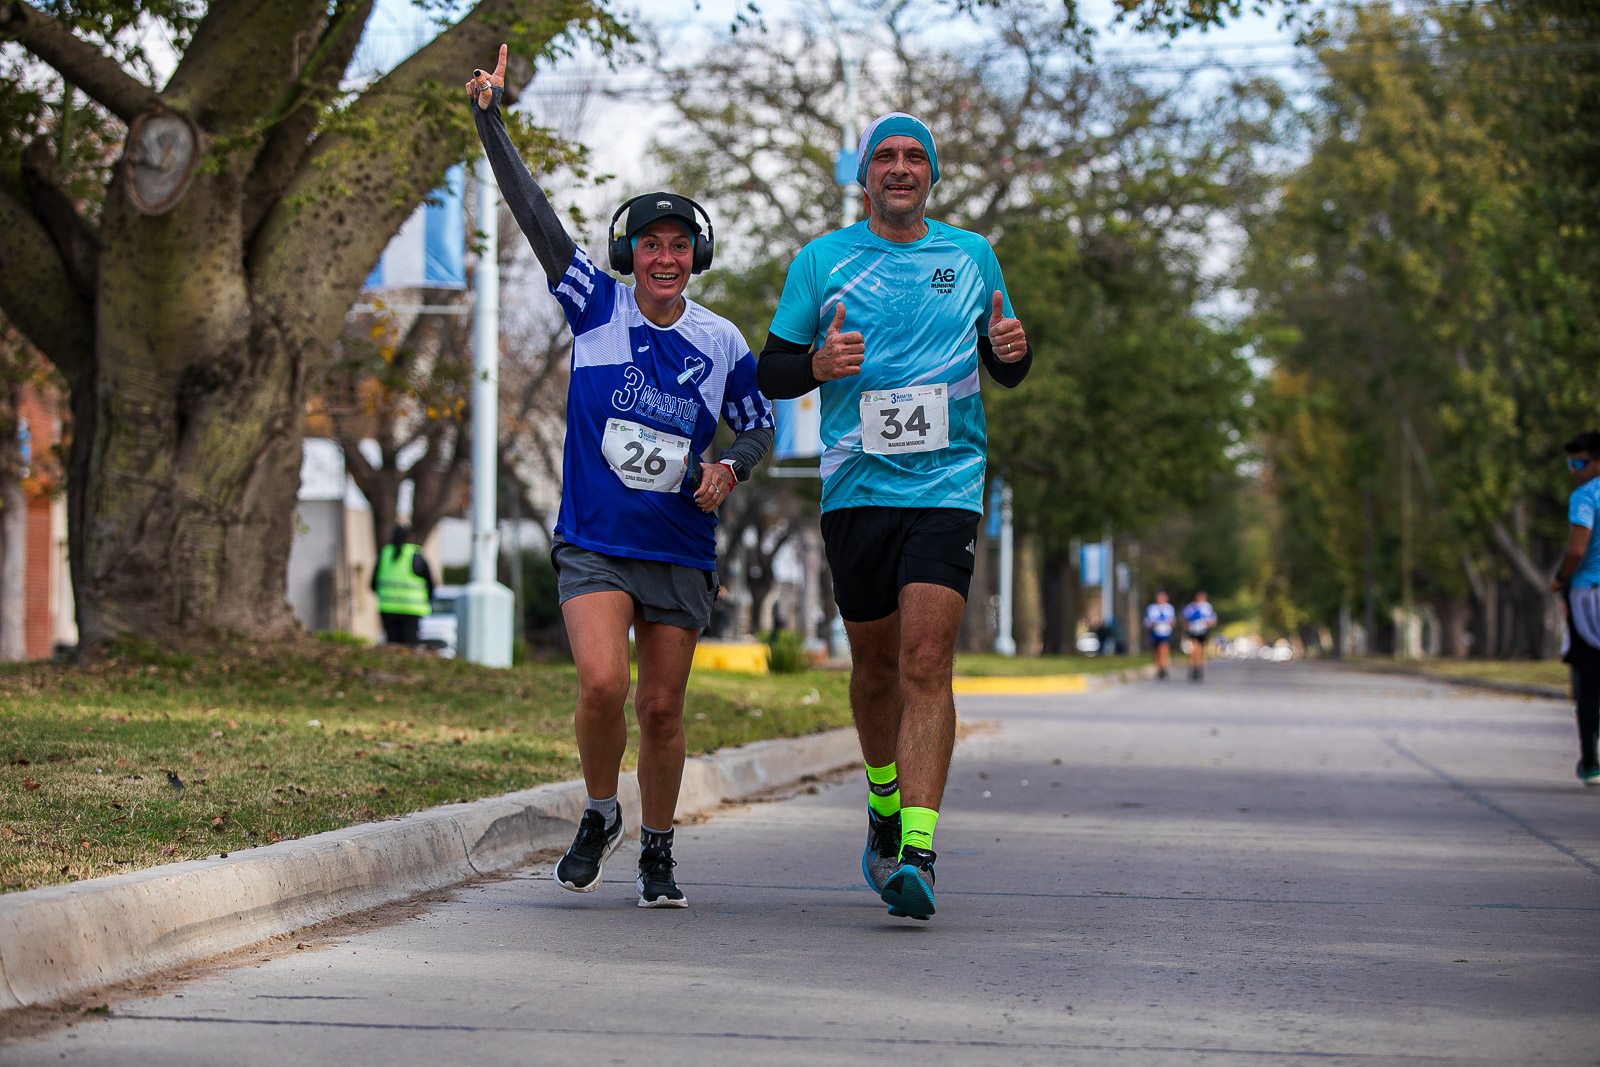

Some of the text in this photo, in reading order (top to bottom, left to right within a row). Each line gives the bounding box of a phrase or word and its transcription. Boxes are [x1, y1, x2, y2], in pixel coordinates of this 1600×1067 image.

[931, 268, 956, 282] AG
[611, 365, 701, 423] 3 MARATÓN
[891, 393, 897, 404] 3
[879, 405, 931, 440] 34
[620, 441, 667, 476] 26
